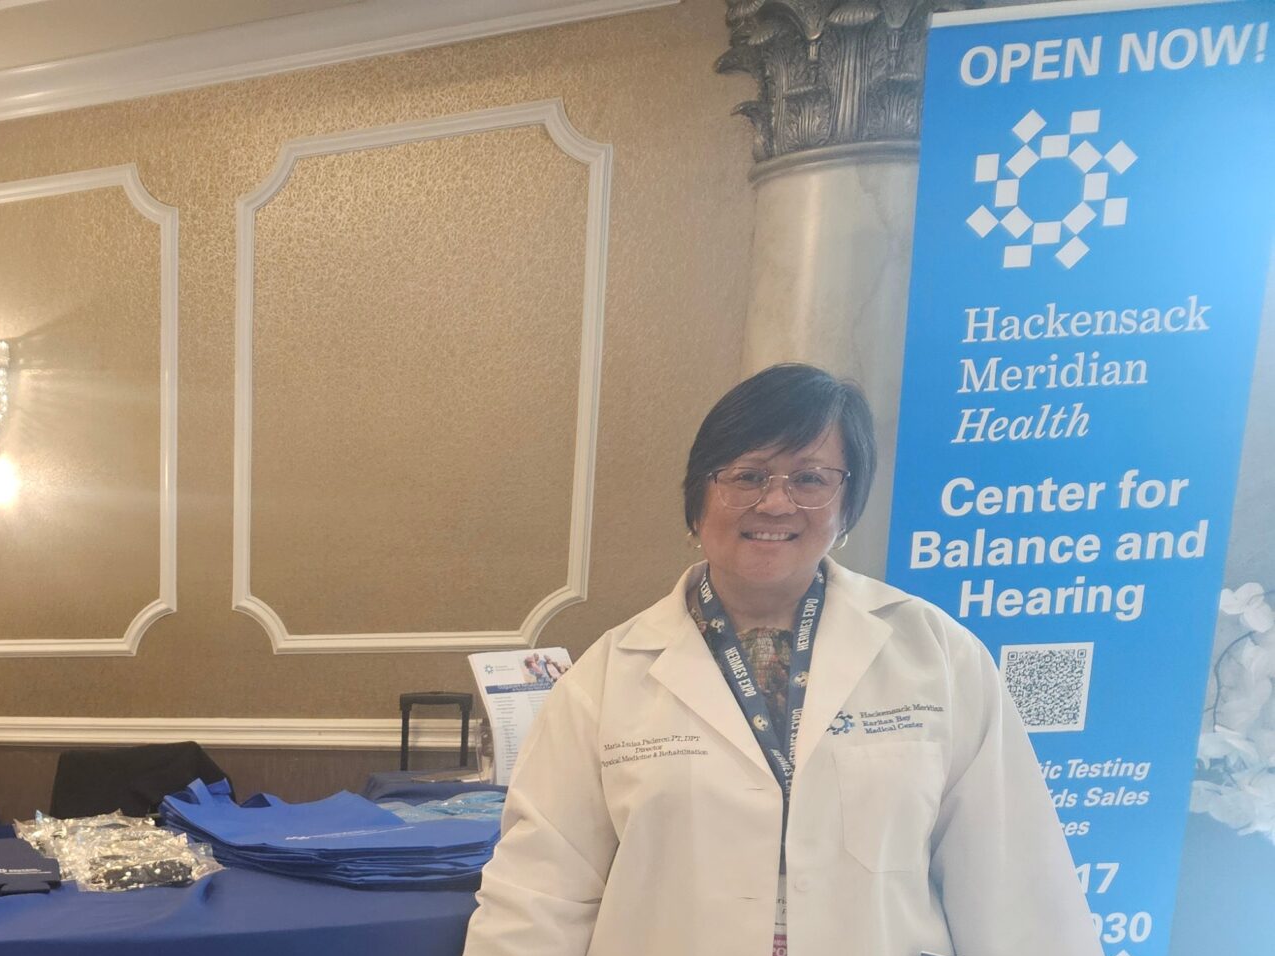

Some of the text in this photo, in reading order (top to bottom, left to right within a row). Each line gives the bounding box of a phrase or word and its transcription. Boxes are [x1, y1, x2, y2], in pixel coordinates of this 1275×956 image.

[960, 22, 1269, 86] OPEN NOW!
[962, 295, 1212, 343] Hackensack
[957, 351, 1148, 394] Meridian
[950, 402, 1090, 444] Health
[941, 469, 1189, 517] Center for
[909, 519, 1209, 569] Balance and
[959, 575, 1145, 622] Hearing
[796, 598, 819, 652] HERMES EXPO
[725, 646, 757, 698] HERMES EXPO
[865, 722, 923, 734] Medical Center
[1067, 757, 1152, 781] Testing
[1084, 786, 1150, 807] Sales
